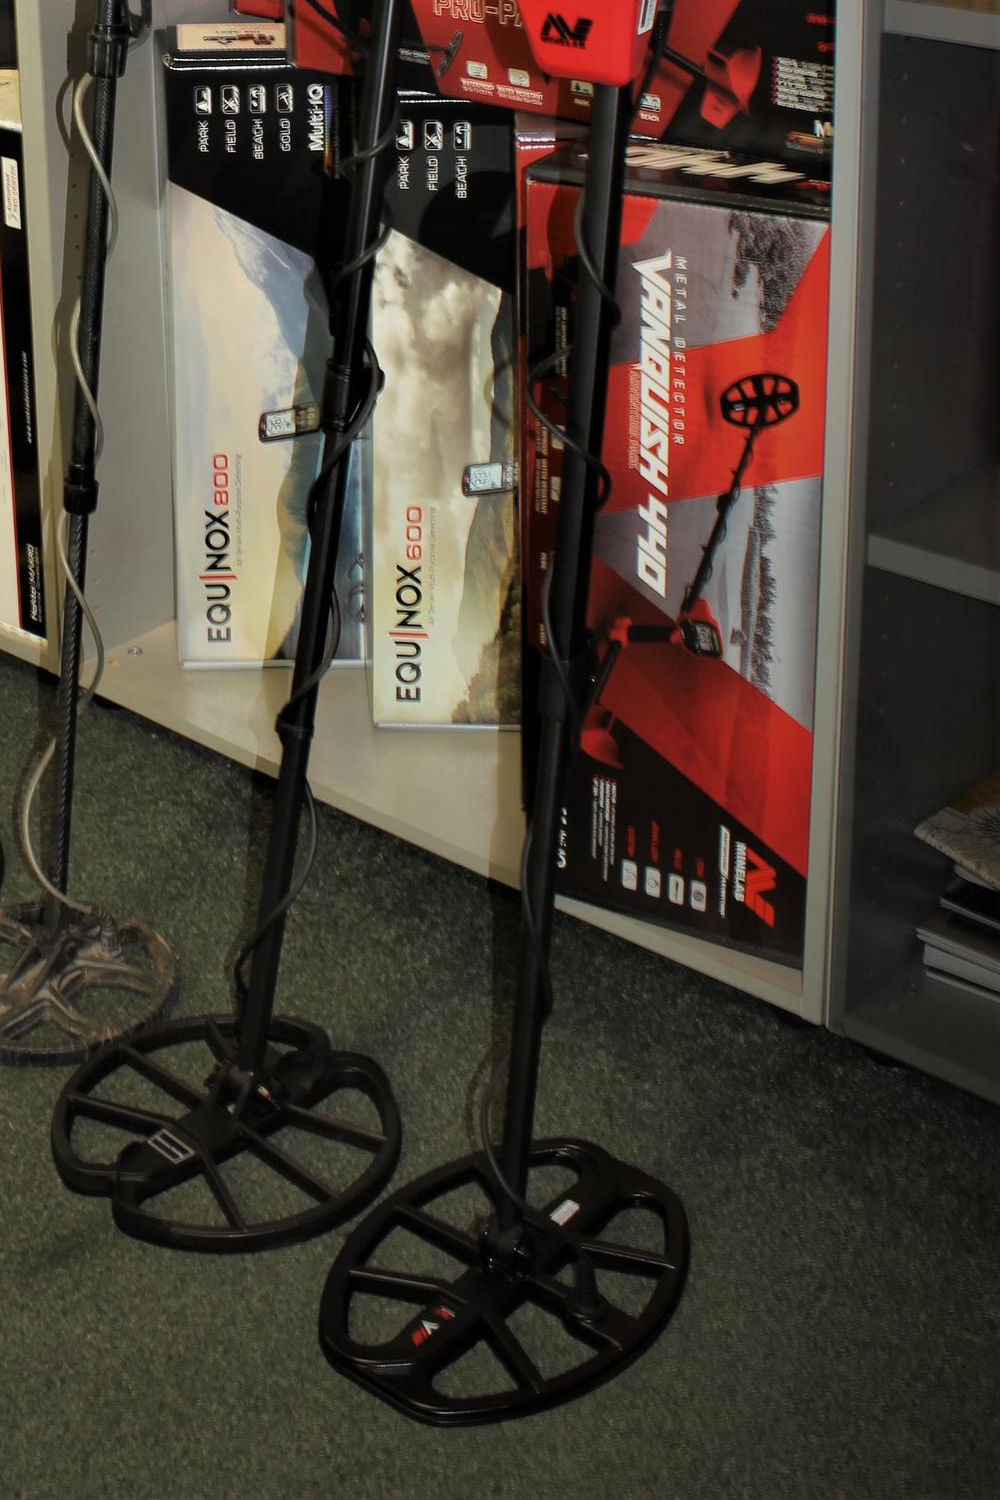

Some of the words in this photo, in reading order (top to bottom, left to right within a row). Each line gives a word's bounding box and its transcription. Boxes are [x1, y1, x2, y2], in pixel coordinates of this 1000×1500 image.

[200, 120, 210, 153] PARK
[226, 119, 237, 154] FIELD
[254, 118, 265, 160] BEACH
[281, 118, 292, 153] GOLD
[307, 82, 325, 152] Multi-IQ
[400, 156, 411, 190] PARK
[427, 155, 439, 192] FIELD
[457, 155, 469, 199] BEACH
[673, 255, 688, 324] METAL
[631, 248, 672, 497] VANQUISH
[672, 336, 688, 446] DETECTOR
[212, 452, 230, 507] 800
[405, 505, 423, 561] 600
[636, 493, 669, 599] 440
[27, 584, 41, 623] Nokta
[199, 509, 239, 644] EQUINOX
[388, 563, 429, 703] EQUINOX
[734, 841, 747, 902] MINELAB
